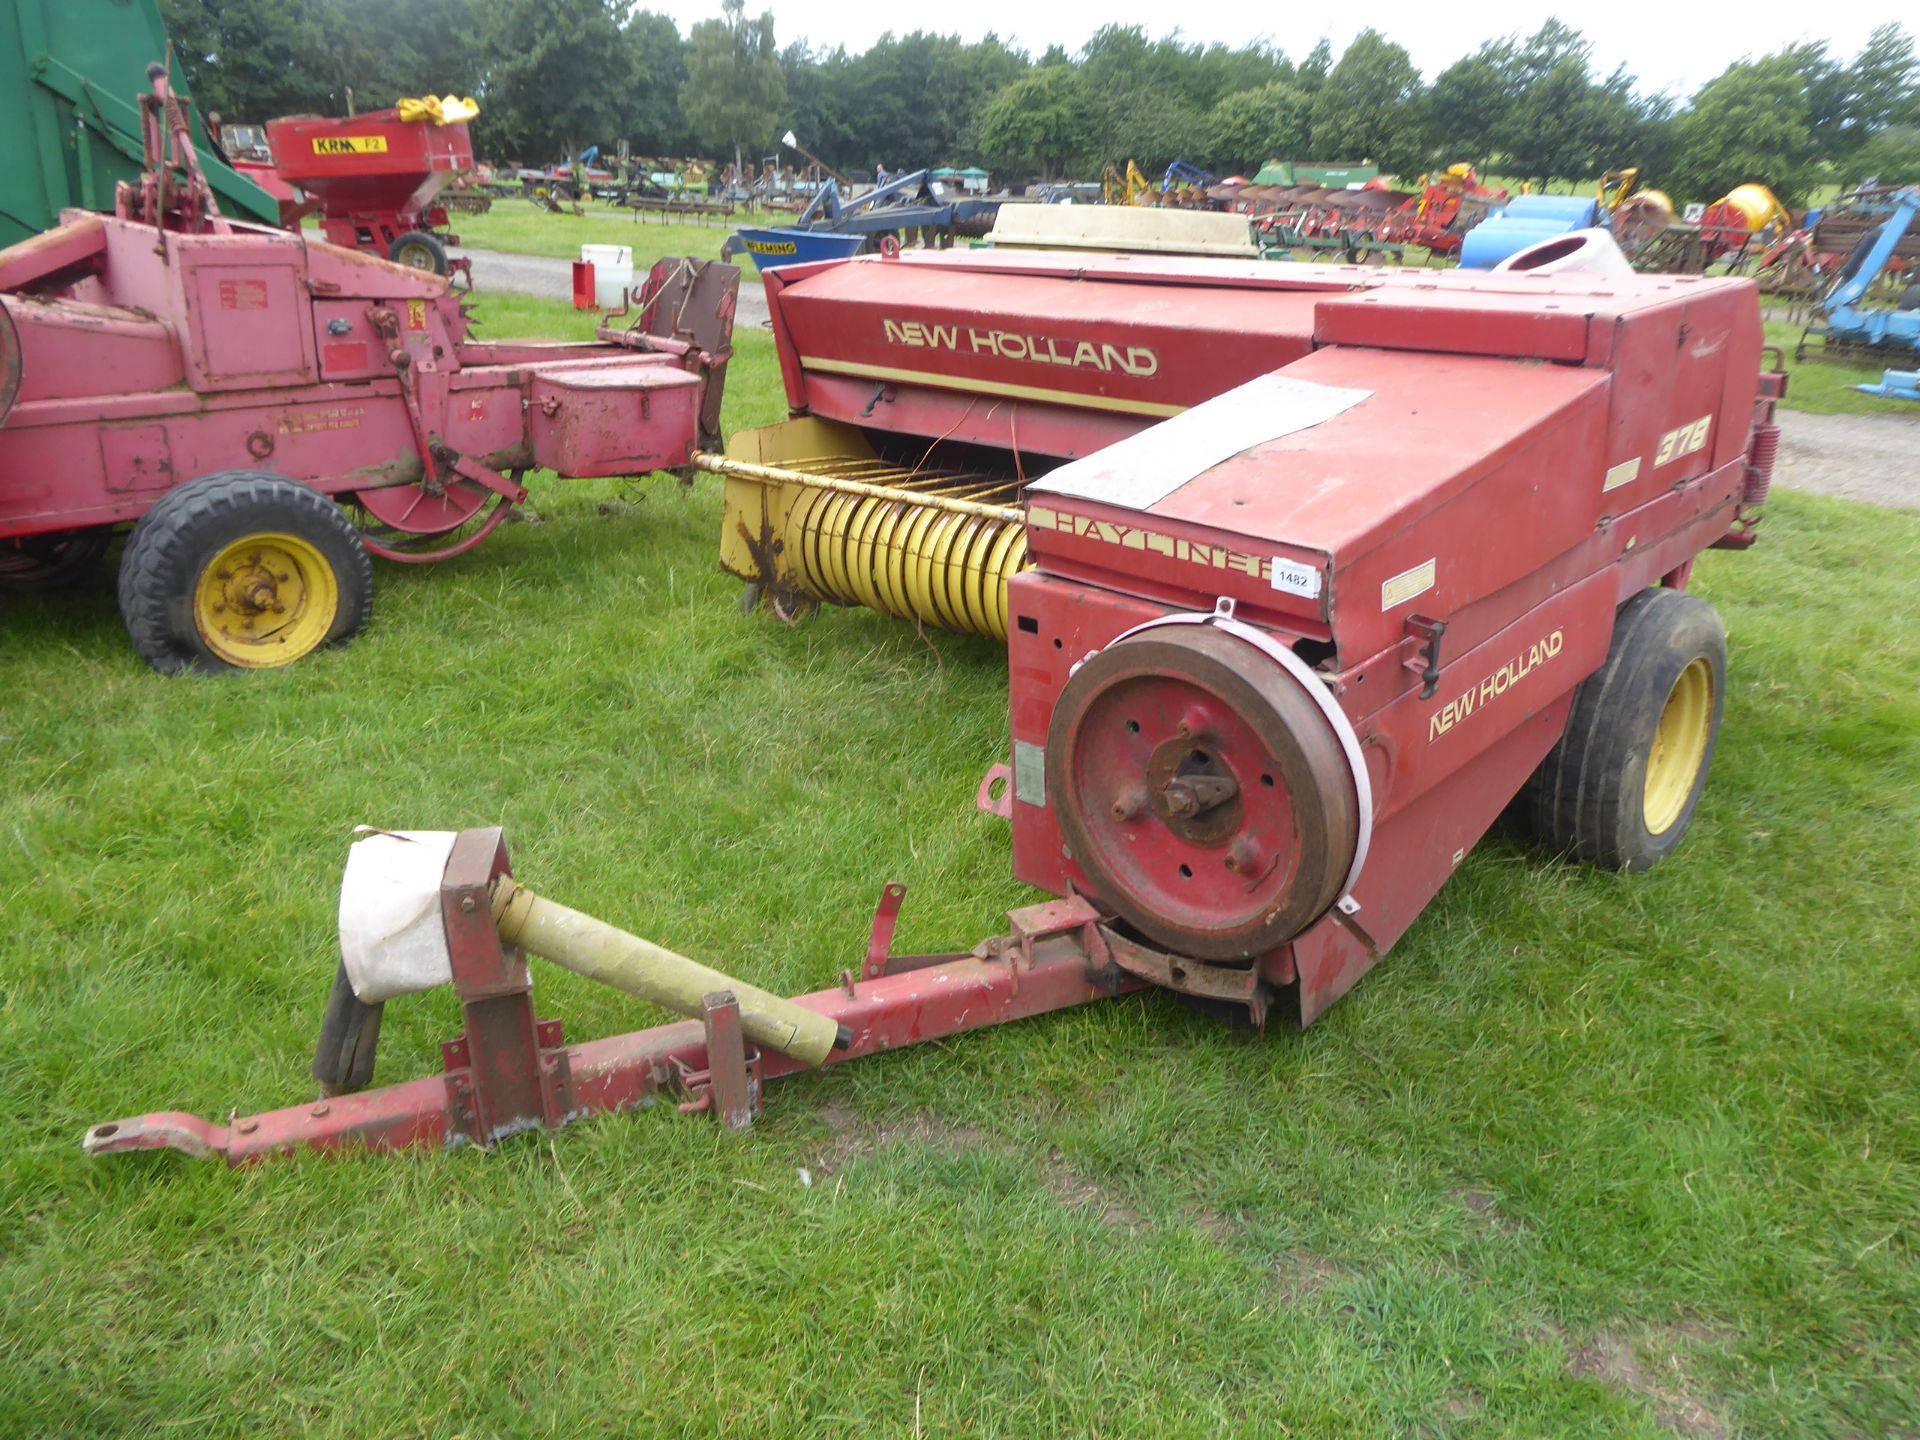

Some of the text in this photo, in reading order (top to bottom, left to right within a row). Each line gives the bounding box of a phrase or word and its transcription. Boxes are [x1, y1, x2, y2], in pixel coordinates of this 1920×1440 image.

[316, 138, 356, 153] KRM
[883, 319, 1158, 377] NEW HOLLAND
[1653, 413, 1712, 467] 378
[1279, 570, 1308, 588] 1482
[1428, 629, 1563, 742] NEW HOLLAND
